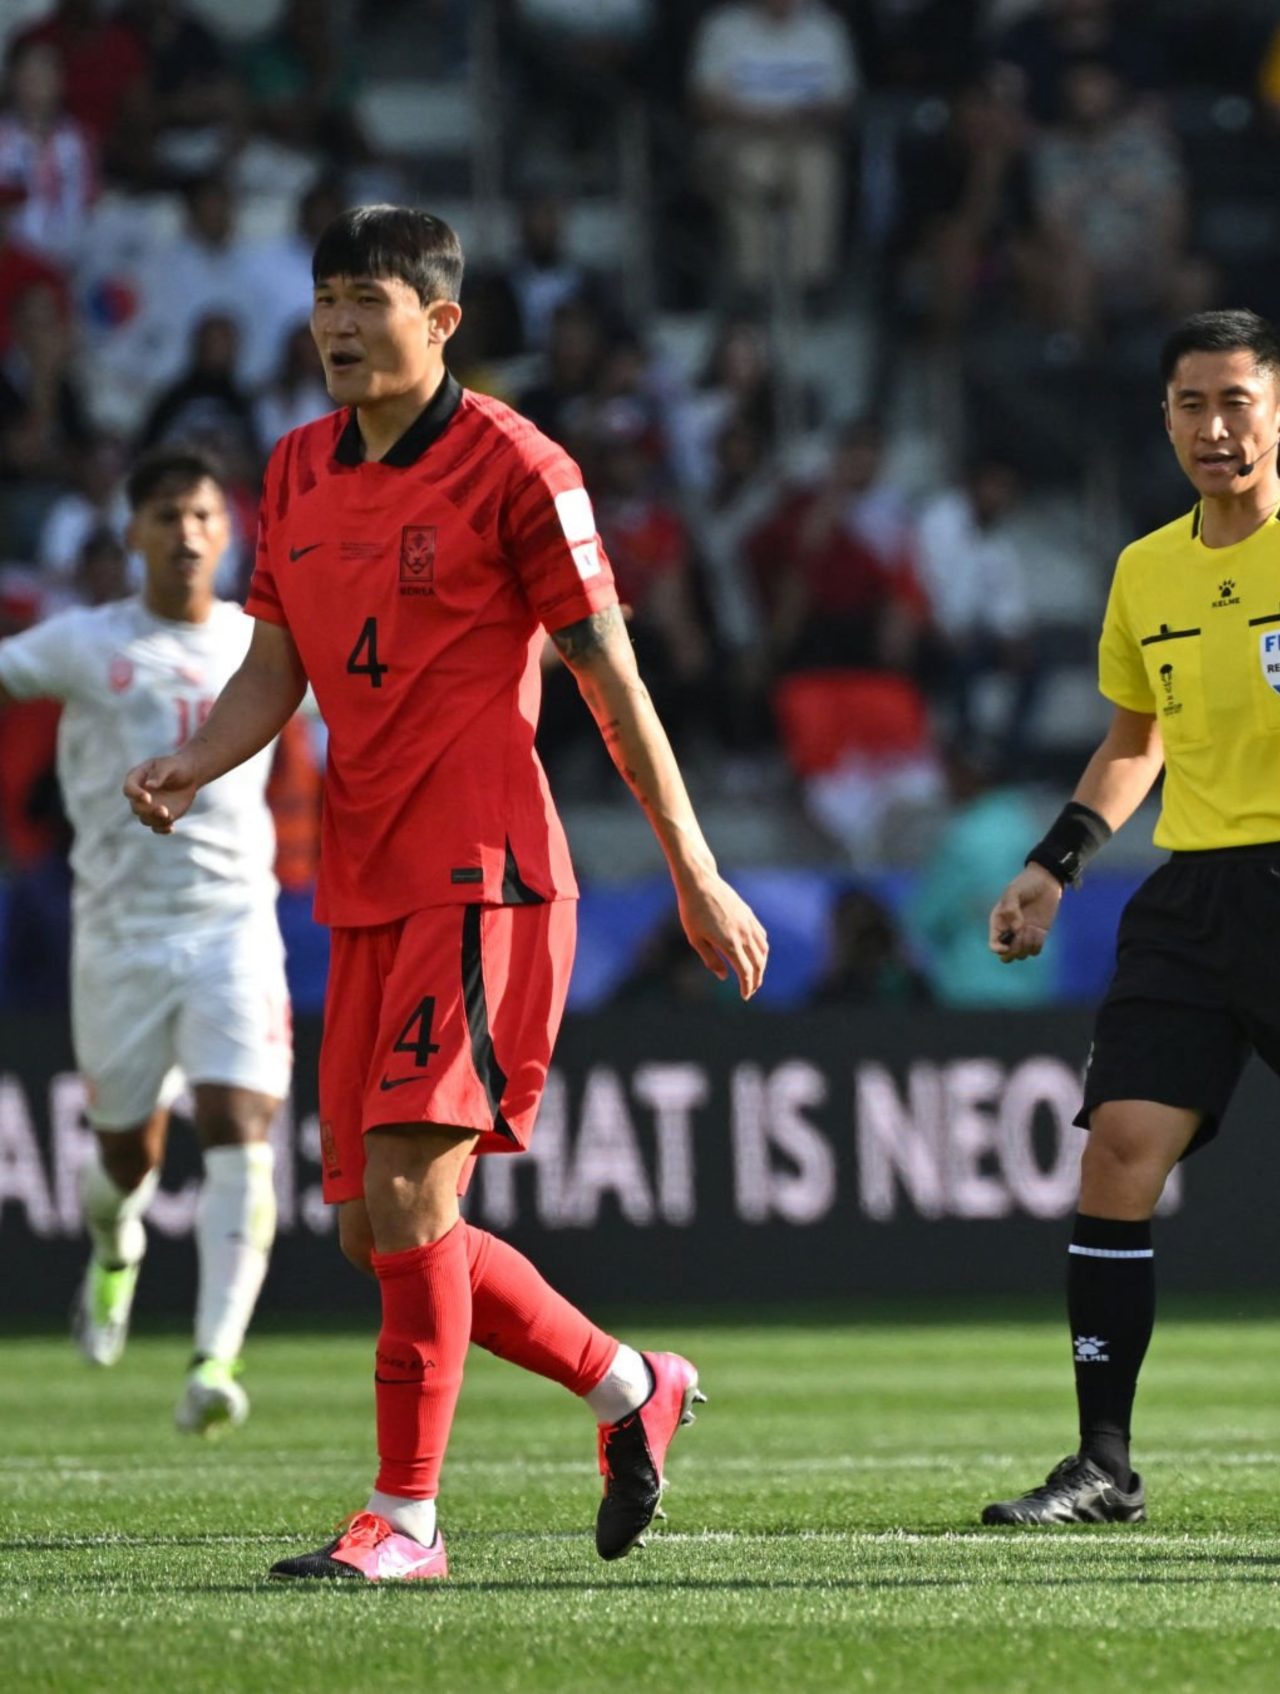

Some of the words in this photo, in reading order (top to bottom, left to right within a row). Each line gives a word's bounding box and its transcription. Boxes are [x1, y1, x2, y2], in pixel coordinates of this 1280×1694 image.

[1211, 597, 1241, 609] KELME
[346, 616, 388, 688] 4
[392, 995, 440, 1067] 4
[464, 1062, 709, 1228] HAT
[731, 1058, 836, 1226] IS
[854, 1054, 1182, 1222] NEO
